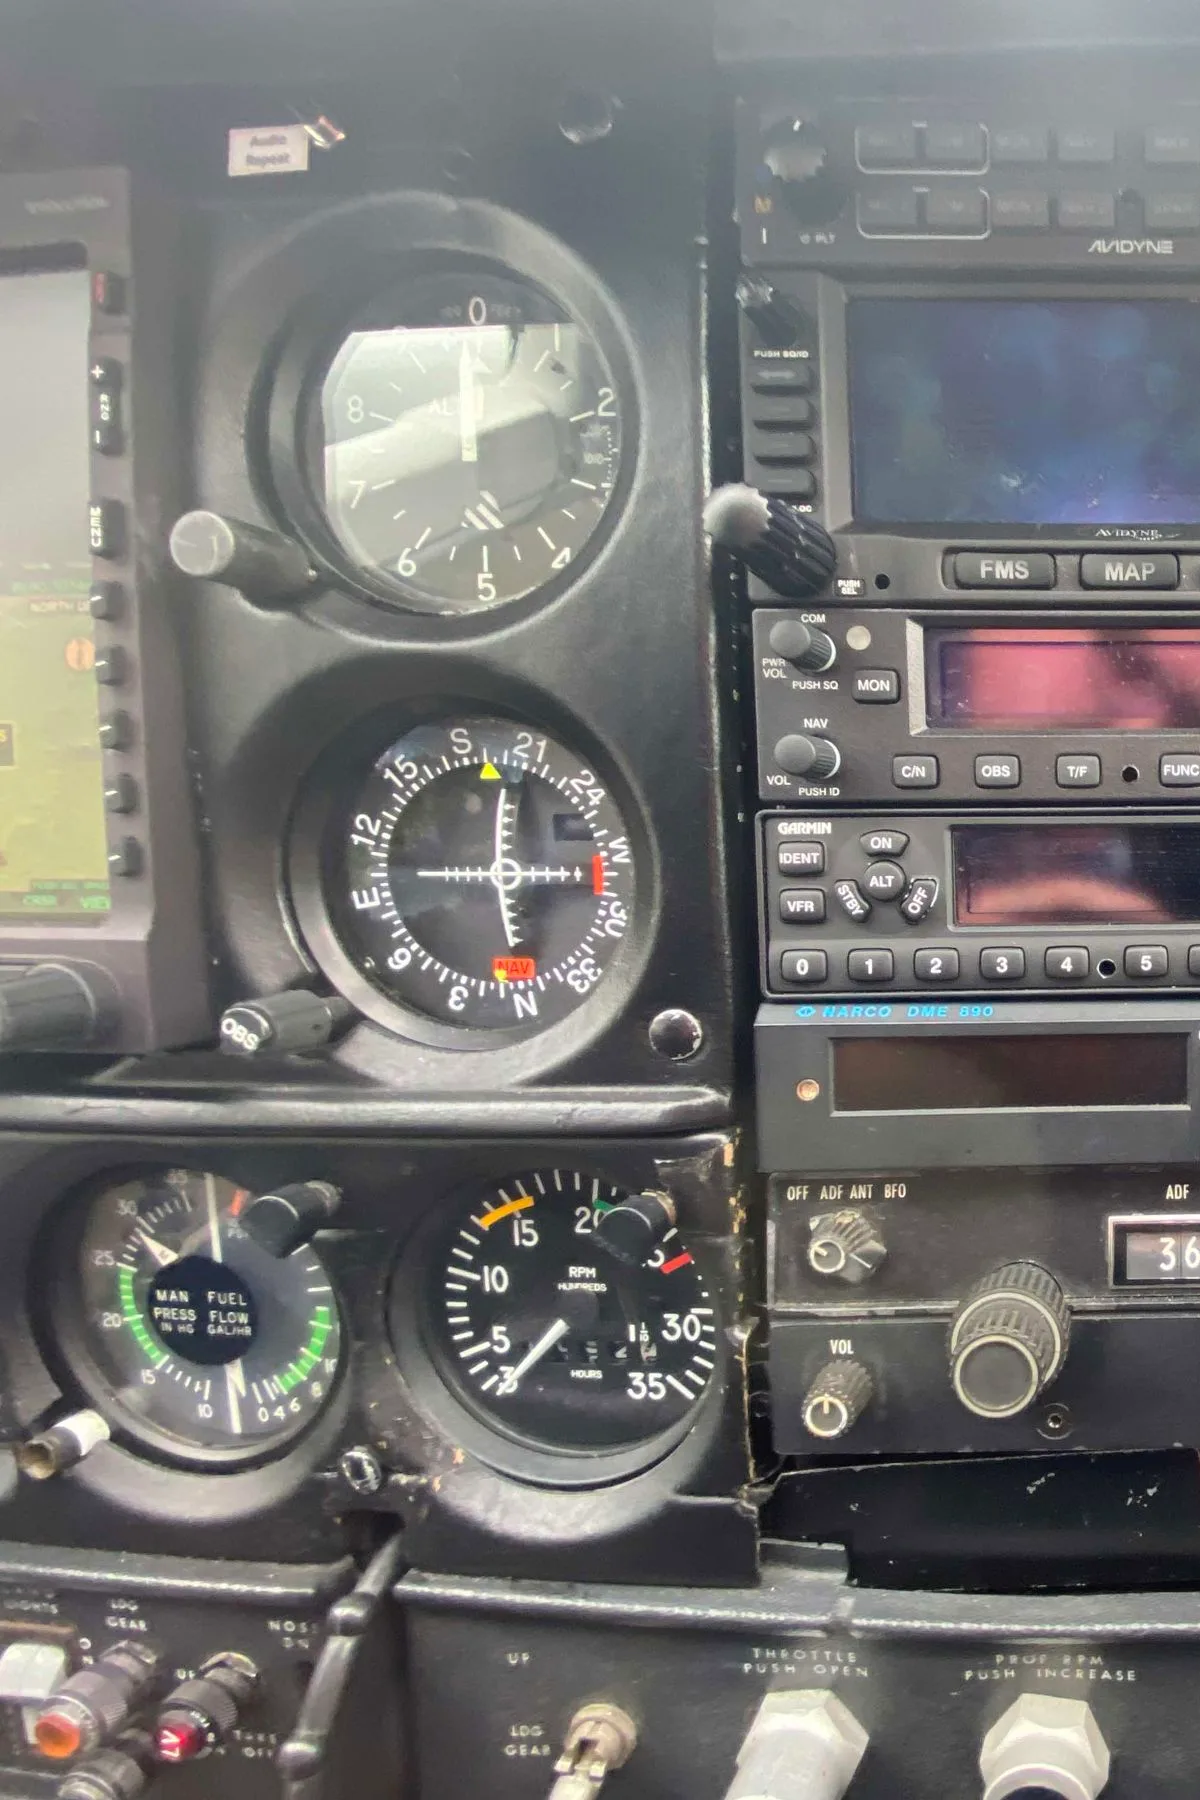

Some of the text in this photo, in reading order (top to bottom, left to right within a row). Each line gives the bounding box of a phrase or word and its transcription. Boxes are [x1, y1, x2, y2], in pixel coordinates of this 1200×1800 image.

[1087, 240, 1174, 254] AVIDYNE
[468, 296, 487, 326] 0
[753, 350, 780, 358] PUSH
[348, 395, 365, 424] 8
[349, 480, 368, 509] 7
[397, 548, 417, 577] 6
[980, 559, 1030, 579] FMS
[1104, 561, 1156, 582] MAP
[477, 573, 497, 602] 5
[801, 613, 826, 624] COM
[762, 658, 786, 668] PWR
[763, 669, 786, 679] VOL
[792, 681, 839, 691] PUSH SQ
[857, 679, 890, 692] MON
[803, 718, 828, 729] NAV
[450, 728, 472, 754] S
[513, 732, 547, 762] 21
[384, 754, 418, 788] 15
[901, 765, 926, 778] C/N
[981, 765, 1010, 778] OBS
[1066, 764, 1088, 778] T/F
[1163, 764, 1200, 777] FUNC
[569, 769, 606, 806] 24
[766, 775, 791, 786] VOL
[798, 786, 840, 797] PUSH ID
[351, 814, 381, 846] 12
[777, 822, 832, 835] GARMIN
[870, 836, 892, 849] ON
[778, 852, 820, 865] IDENT
[869, 875, 895, 888] ALT
[352, 887, 380, 909] E
[837, 884, 863, 917] STBY
[908, 887, 928, 915] OFF
[787, 900, 815, 913] VFR
[796, 958, 809, 976] 0
[864, 958, 873, 975] 1
[930, 957, 942, 974] 2
[996, 956, 1008, 973] 3
[1060, 956, 1073, 973] 4
[1140, 954, 1152, 971] 5
[567, 957, 603, 994] 33
[448, 985, 469, 1012] 3
[513, 991, 538, 1018] N
[822, 1006, 993, 1017] NARCO DME 890
[221, 1018, 259, 1051] OBS
[787, 1184, 906, 1201] OFF ADF ANT BFO
[1166, 1184, 1190, 1199] ADF
[513, 1219, 540, 1247] 15
[483, 1264, 509, 1293] 10
[569, 1267, 596, 1278] RPM
[156, 1289, 190, 1302] MAN
[558, 1283, 607, 1292] HUNDREDS
[207, 1291, 248, 1306] FUEL
[103, 1313, 123, 1328] 20
[154, 1307, 197, 1321] PRESS
[209, 1310, 249, 1324] FLOW
[661, 1313, 701, 1342] 30
[491, 1325, 511, 1354] 5
[830, 1339, 854, 1355] VOL
[570, 1369, 602, 1379] HOURS
[627, 1371, 666, 1400] 35
[198, 1404, 213, 1419] 10
[752, 1647, 857, 1663] THROTTLE
[743, 1662, 868, 1678] PUSH OPEN
[964, 1668, 1137, 1682] PUSH INCREASE
[510, 1724, 544, 1737] LDG
[504, 1744, 551, 1756] GEAR
